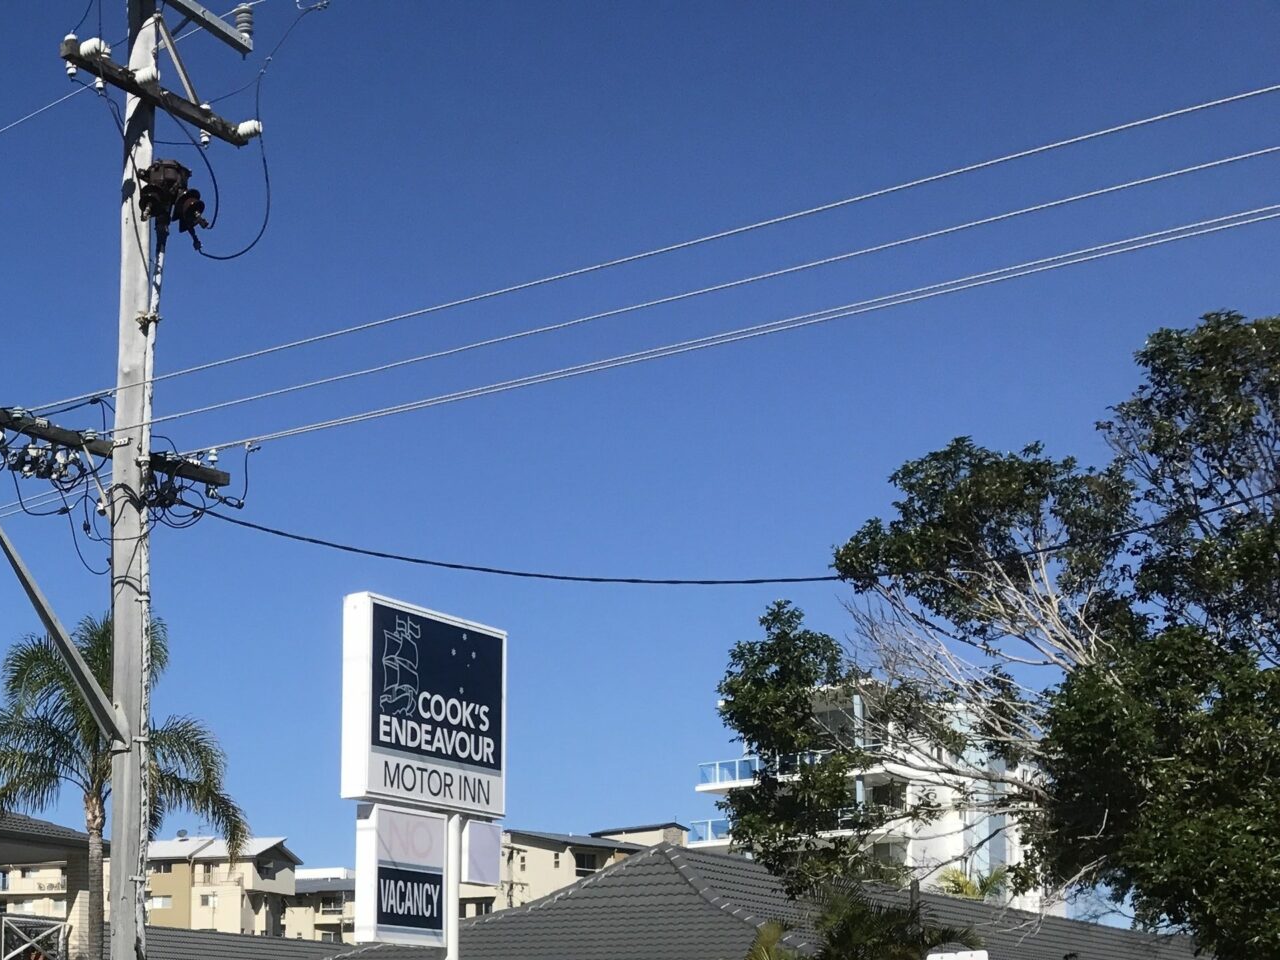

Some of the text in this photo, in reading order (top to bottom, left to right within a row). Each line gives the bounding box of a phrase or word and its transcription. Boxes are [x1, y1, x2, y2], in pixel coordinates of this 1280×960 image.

[418, 691, 490, 732] COOK'S
[379, 714, 495, 764] ENDEAVOUR
[384, 760, 490, 805] MOTOR INN
[380, 878, 440, 917] VACANCY
